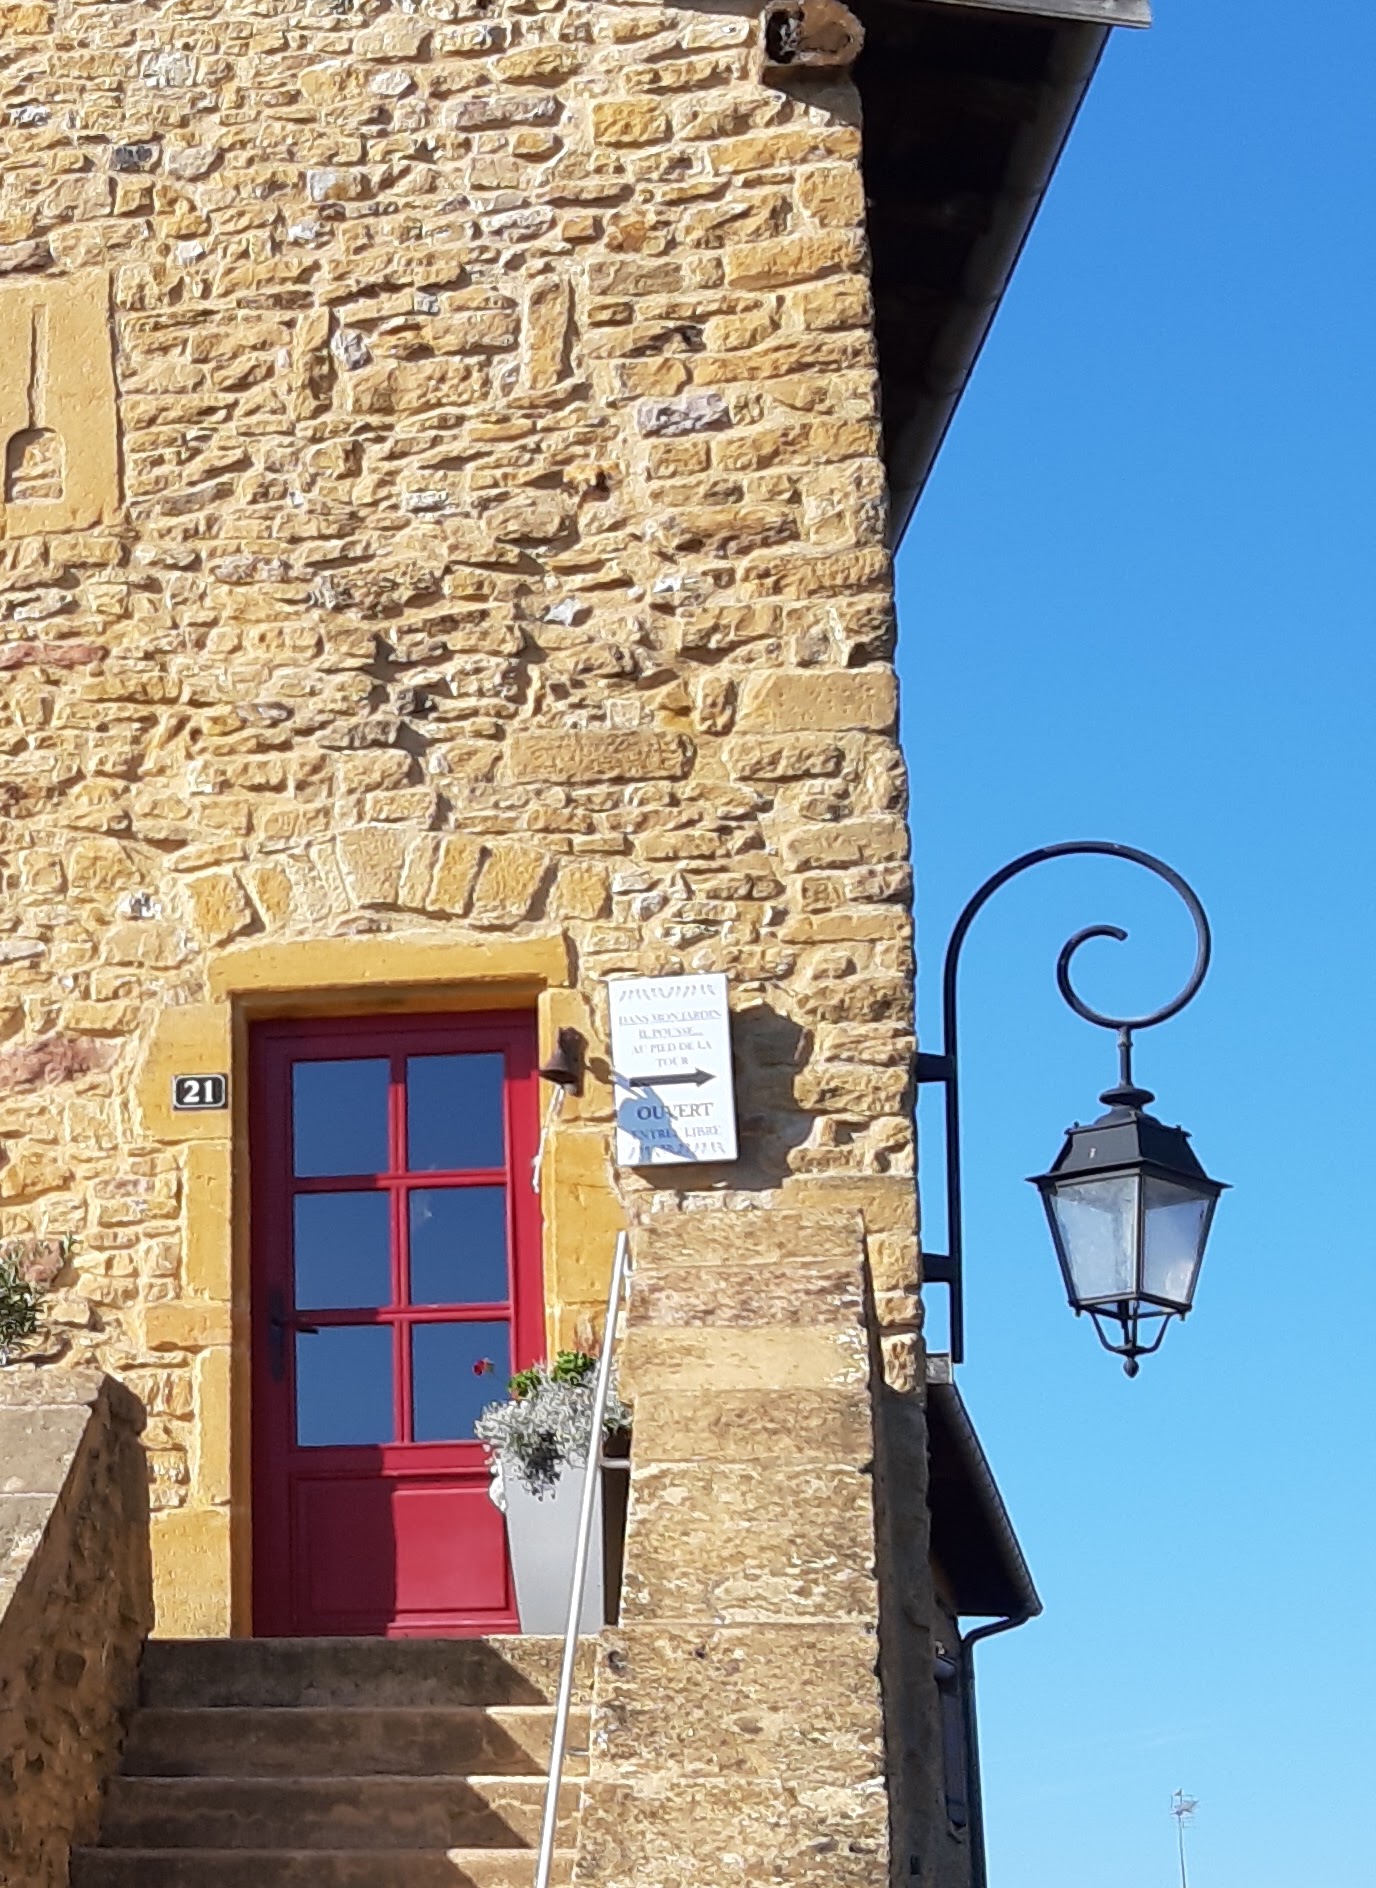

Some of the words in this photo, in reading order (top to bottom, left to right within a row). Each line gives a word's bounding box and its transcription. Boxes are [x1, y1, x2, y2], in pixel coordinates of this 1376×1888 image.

[650, 1042, 676, 1053] PIED
[679, 1041, 695, 1051] DE
[697, 1039, 712, 1050] LA
[657, 1056, 689, 1068] TOUR
[183, 1079, 214, 1103] 21
[636, 1102, 714, 1121] OUVERT
[684, 1125, 720, 1138] LIBRE
